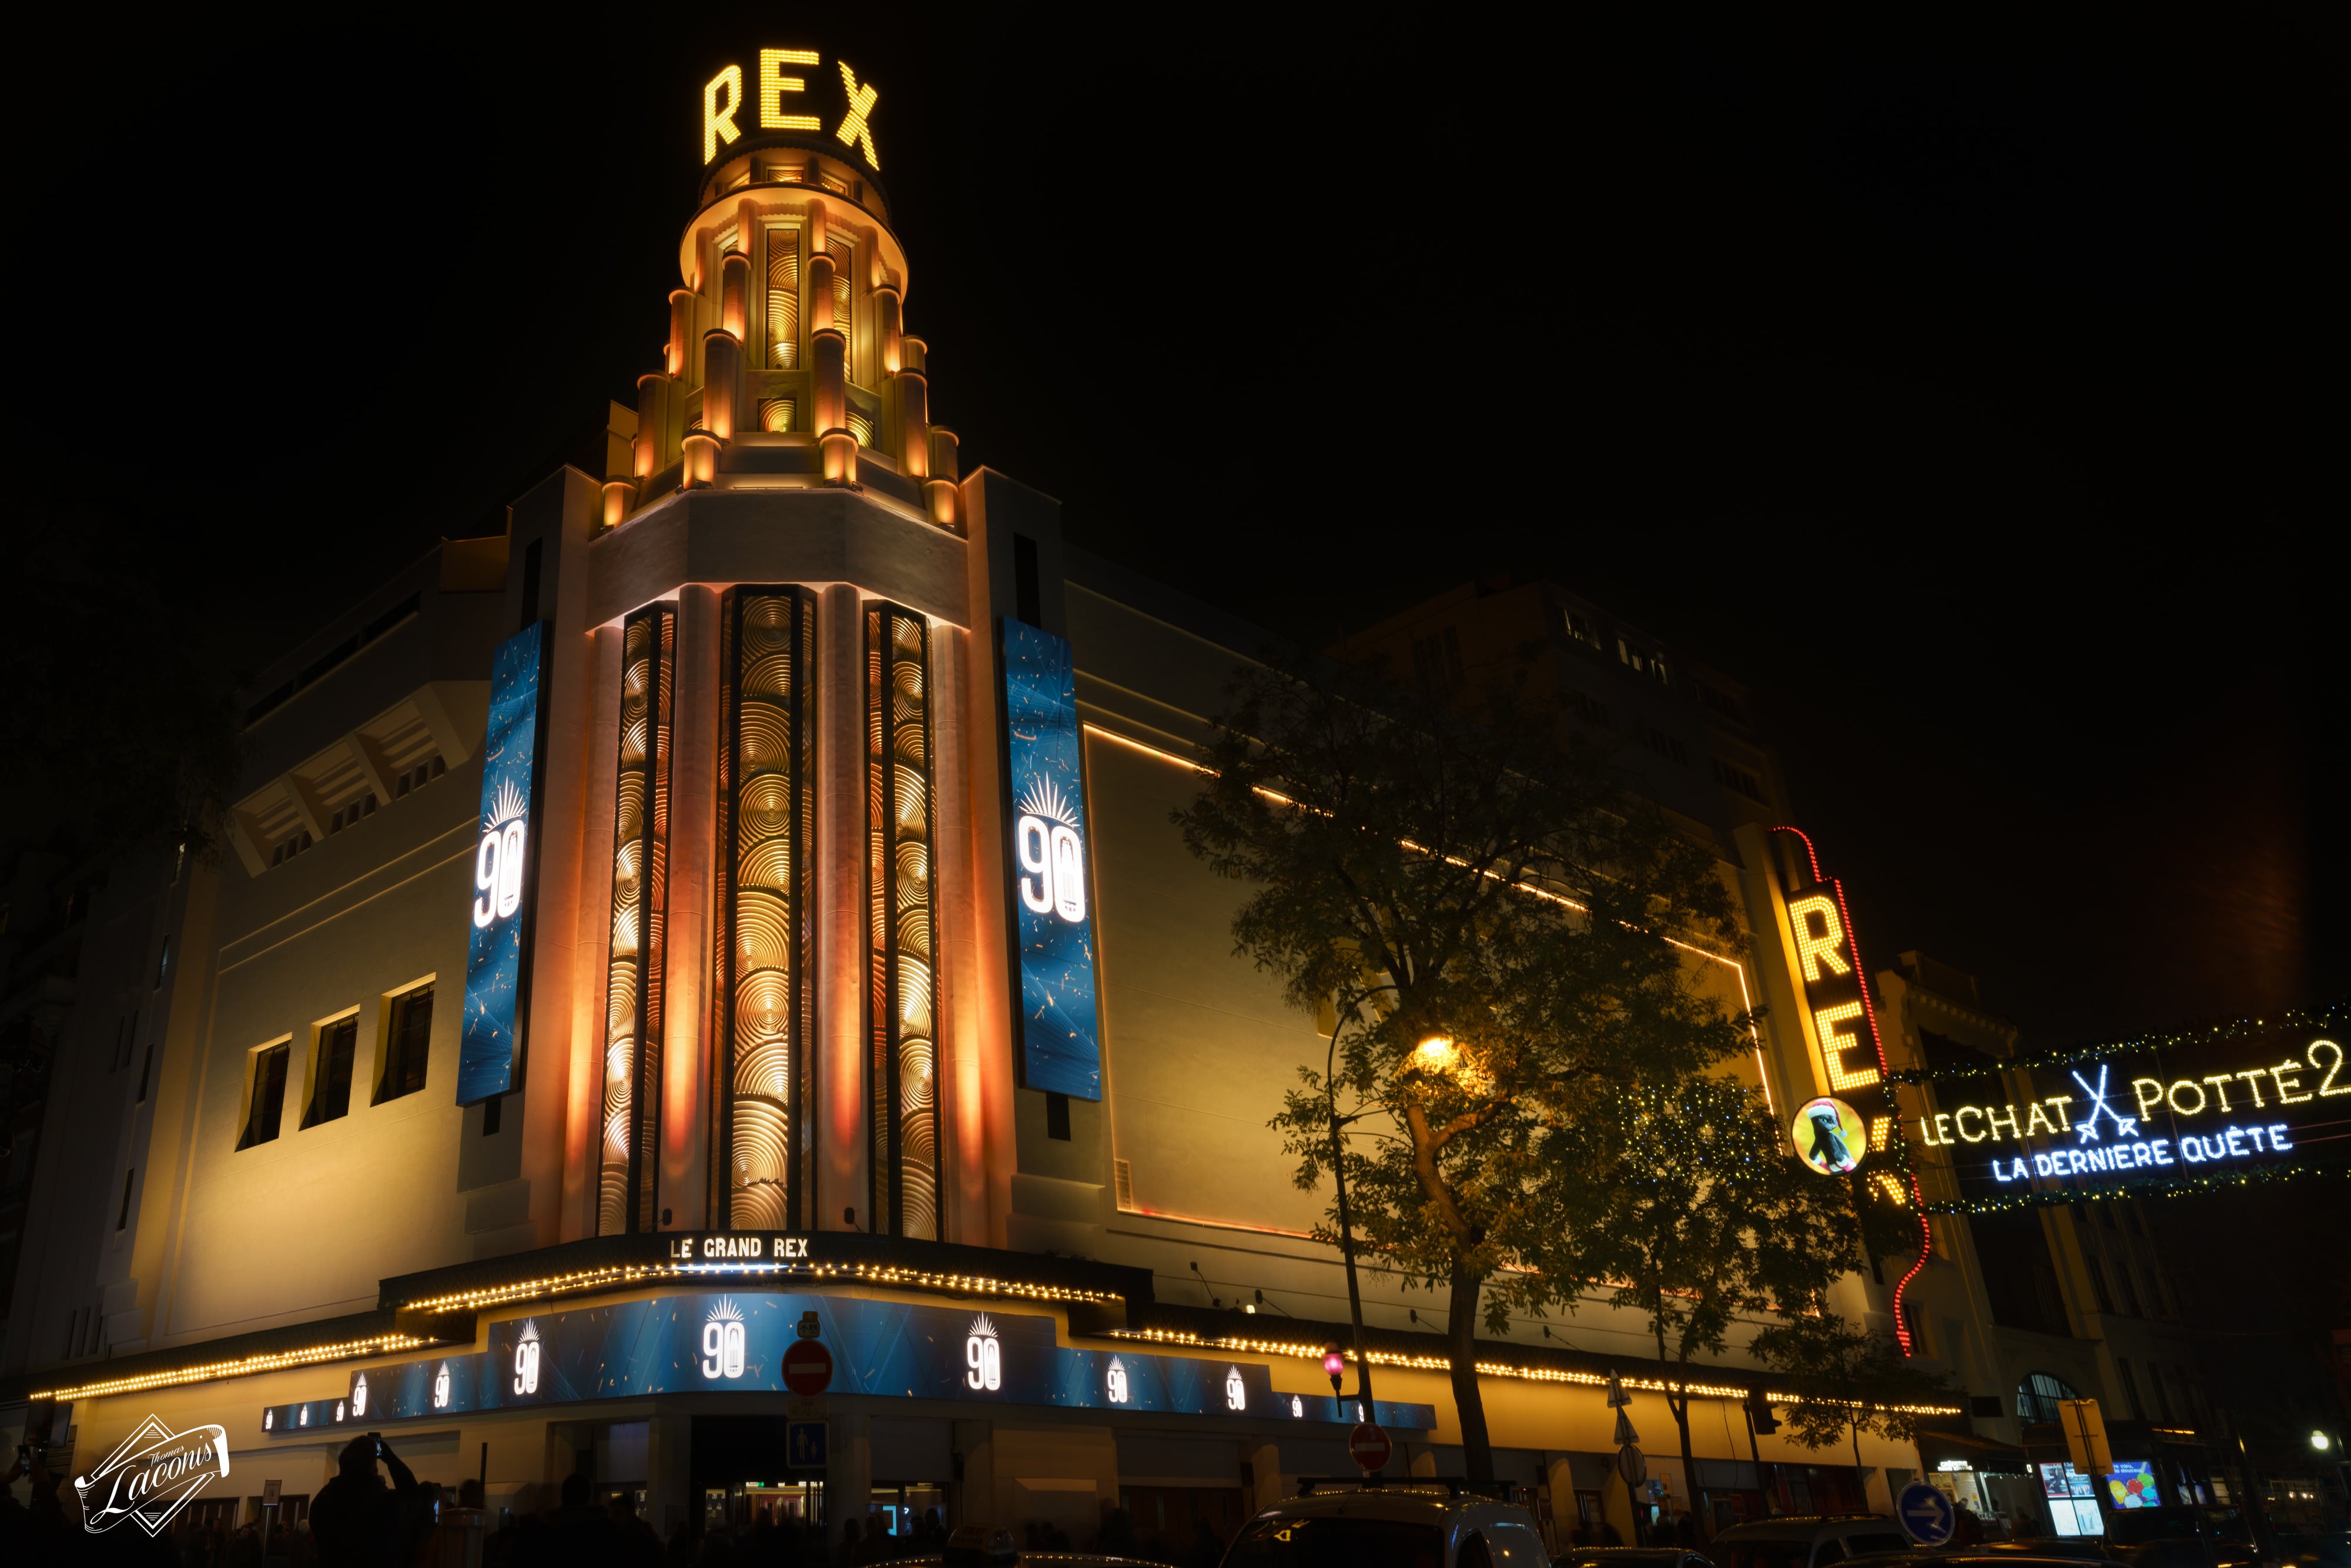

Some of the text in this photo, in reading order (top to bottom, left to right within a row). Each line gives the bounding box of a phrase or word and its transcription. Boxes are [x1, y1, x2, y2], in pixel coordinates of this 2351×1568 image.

[704, 48, 880, 171] REX
[474, 820, 525, 928] 90
[1019, 815, 1086, 923] 90
[2133, 1059, 2312, 1122] POTTÉ
[2307, 1040, 2351, 1097] 2
[1992, 1124, 2293, 1182] LA DERNIERE QUÊTE
[671, 1237, 808, 1258] LE GRAND REX
[703, 1321, 745, 1379] 90
[967, 1336, 1000, 1391] 90
[514, 1342, 540, 1395] 90
[353, 1386, 367, 1416] 90
[434, 1376, 450, 1408] 90
[1108, 1370, 1127, 1403] 90
[1227, 1379, 1245, 1410] 90
[266, 1414, 273, 1429] 90
[300, 1409, 307, 1425] 90
[336, 1405, 344, 1421] 90
[1292, 1400, 1302, 1417] 90
[1359, 1405, 1364, 1422] 9
